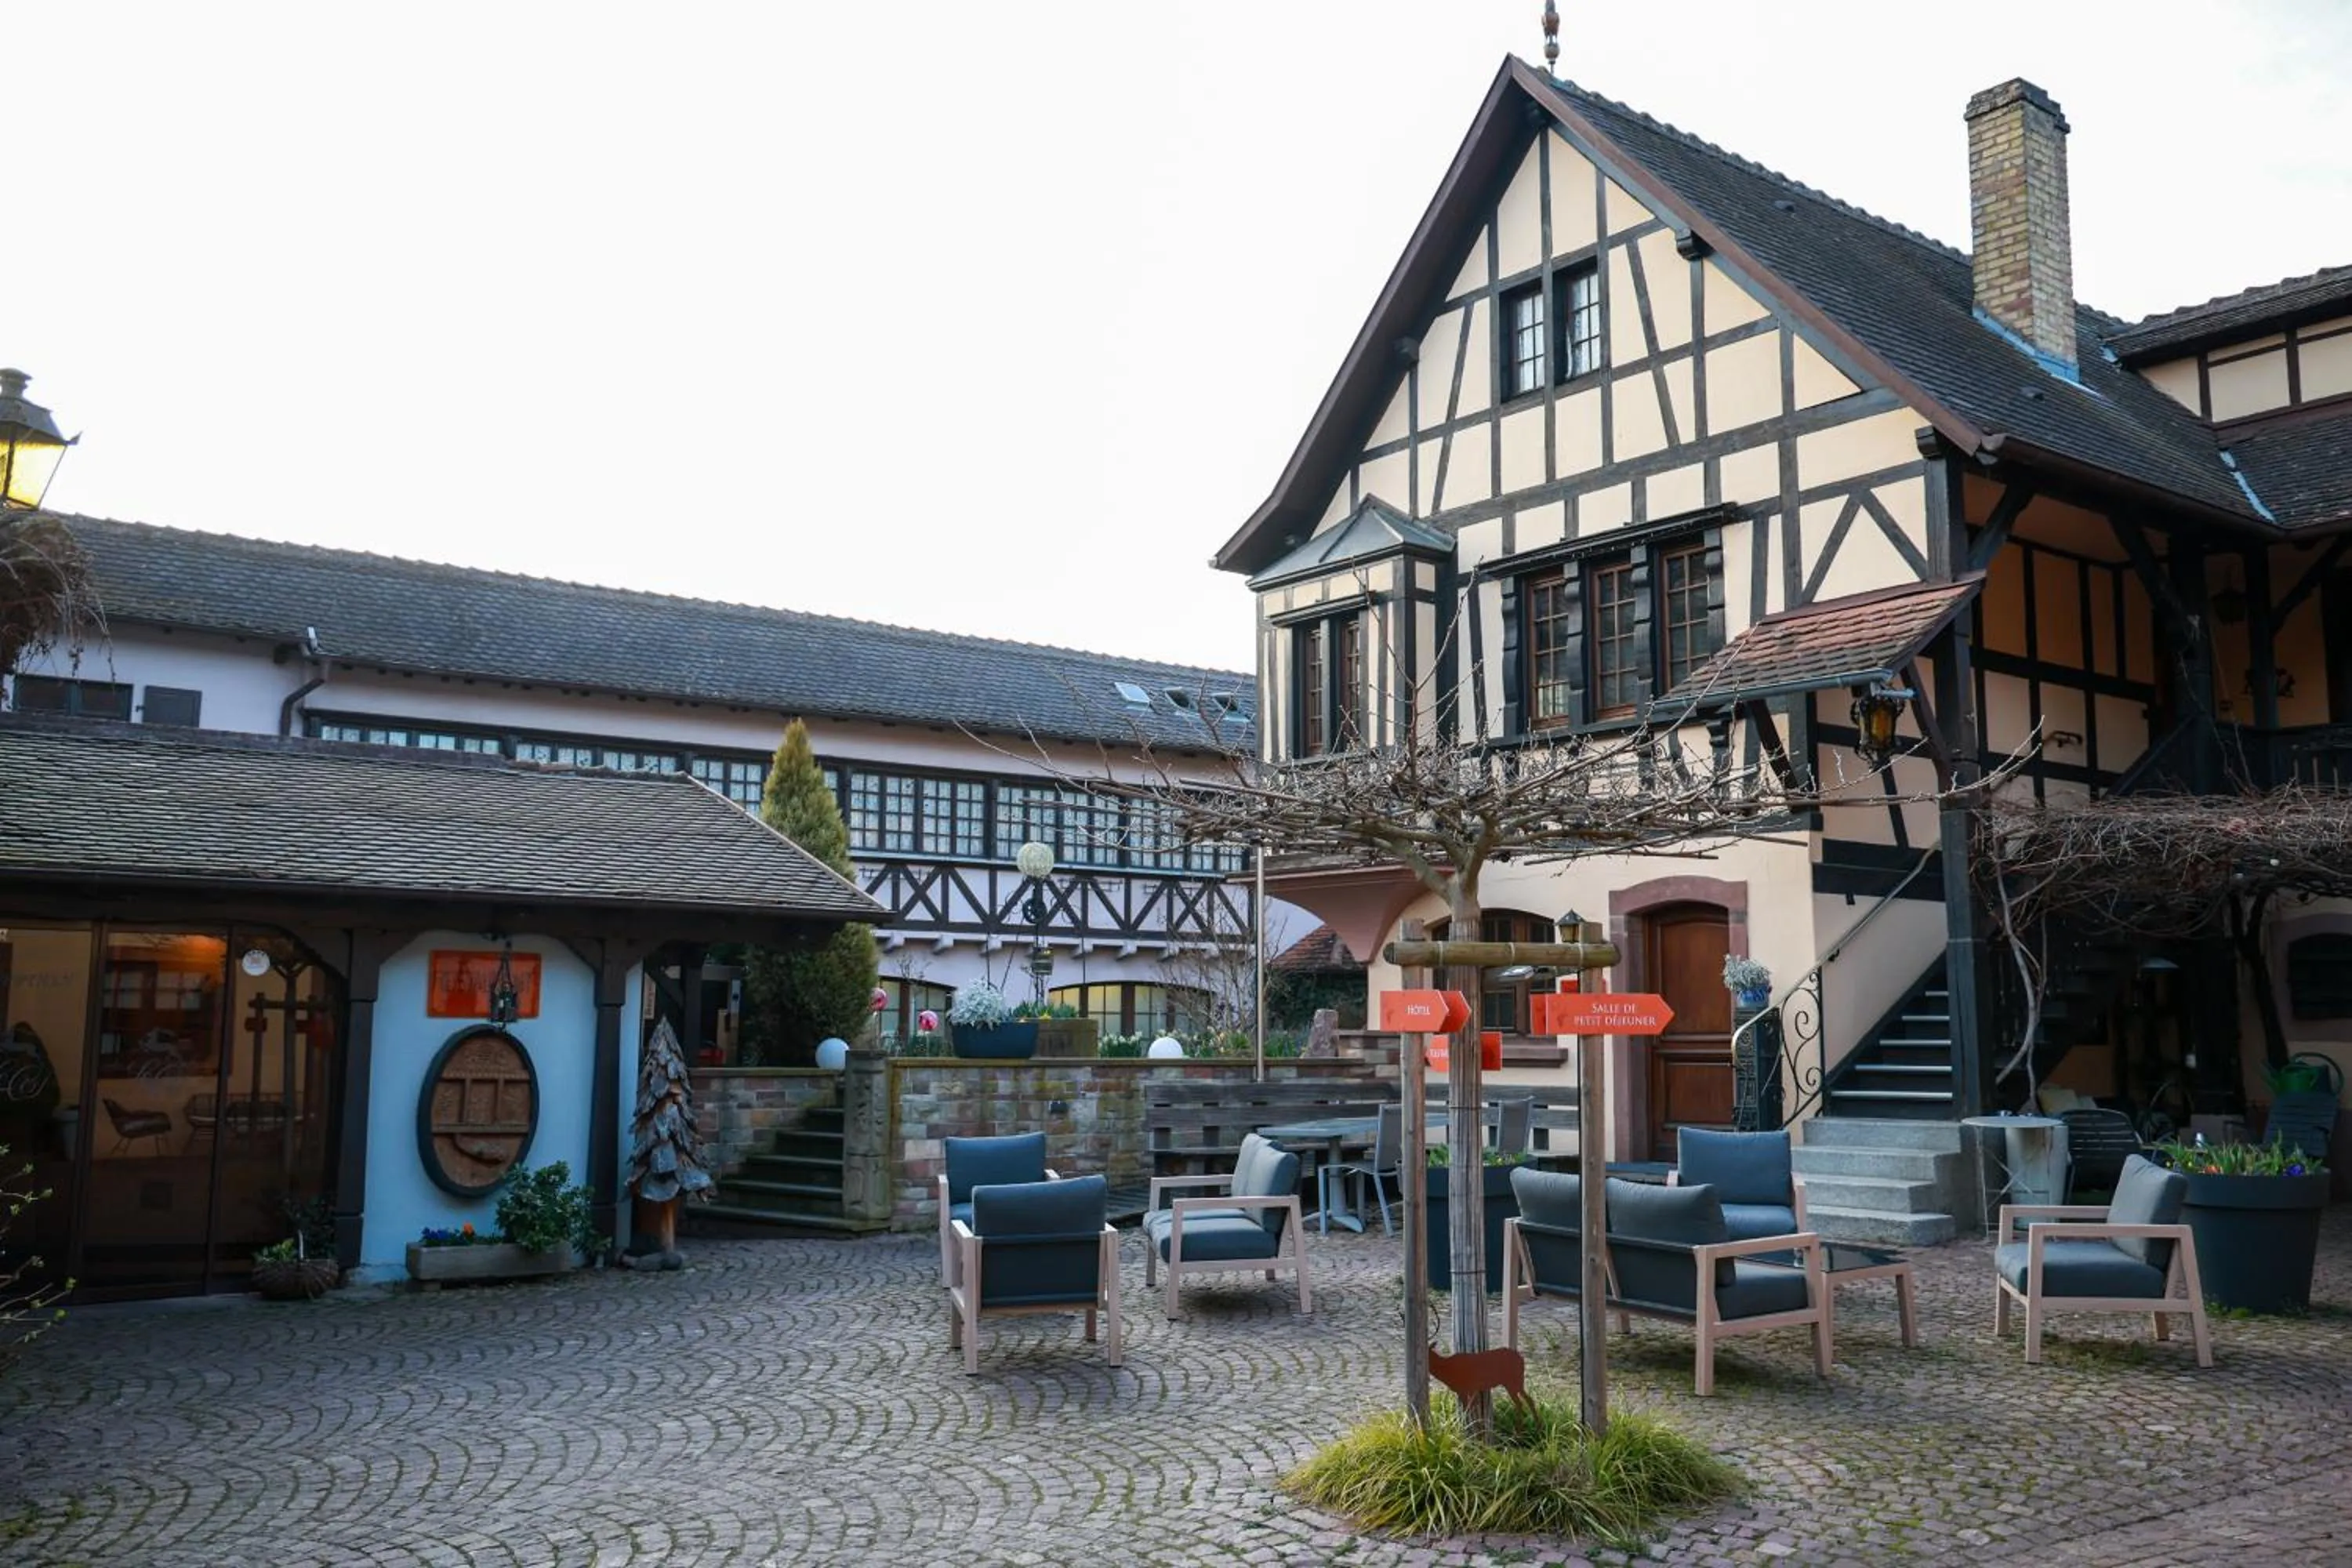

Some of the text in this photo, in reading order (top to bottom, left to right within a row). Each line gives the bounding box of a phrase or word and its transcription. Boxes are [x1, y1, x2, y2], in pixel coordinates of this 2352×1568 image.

[1592, 1003, 1636, 1014] SALLE DE
[1573, 1014, 1656, 1026] PETIT DÉJEUNER
